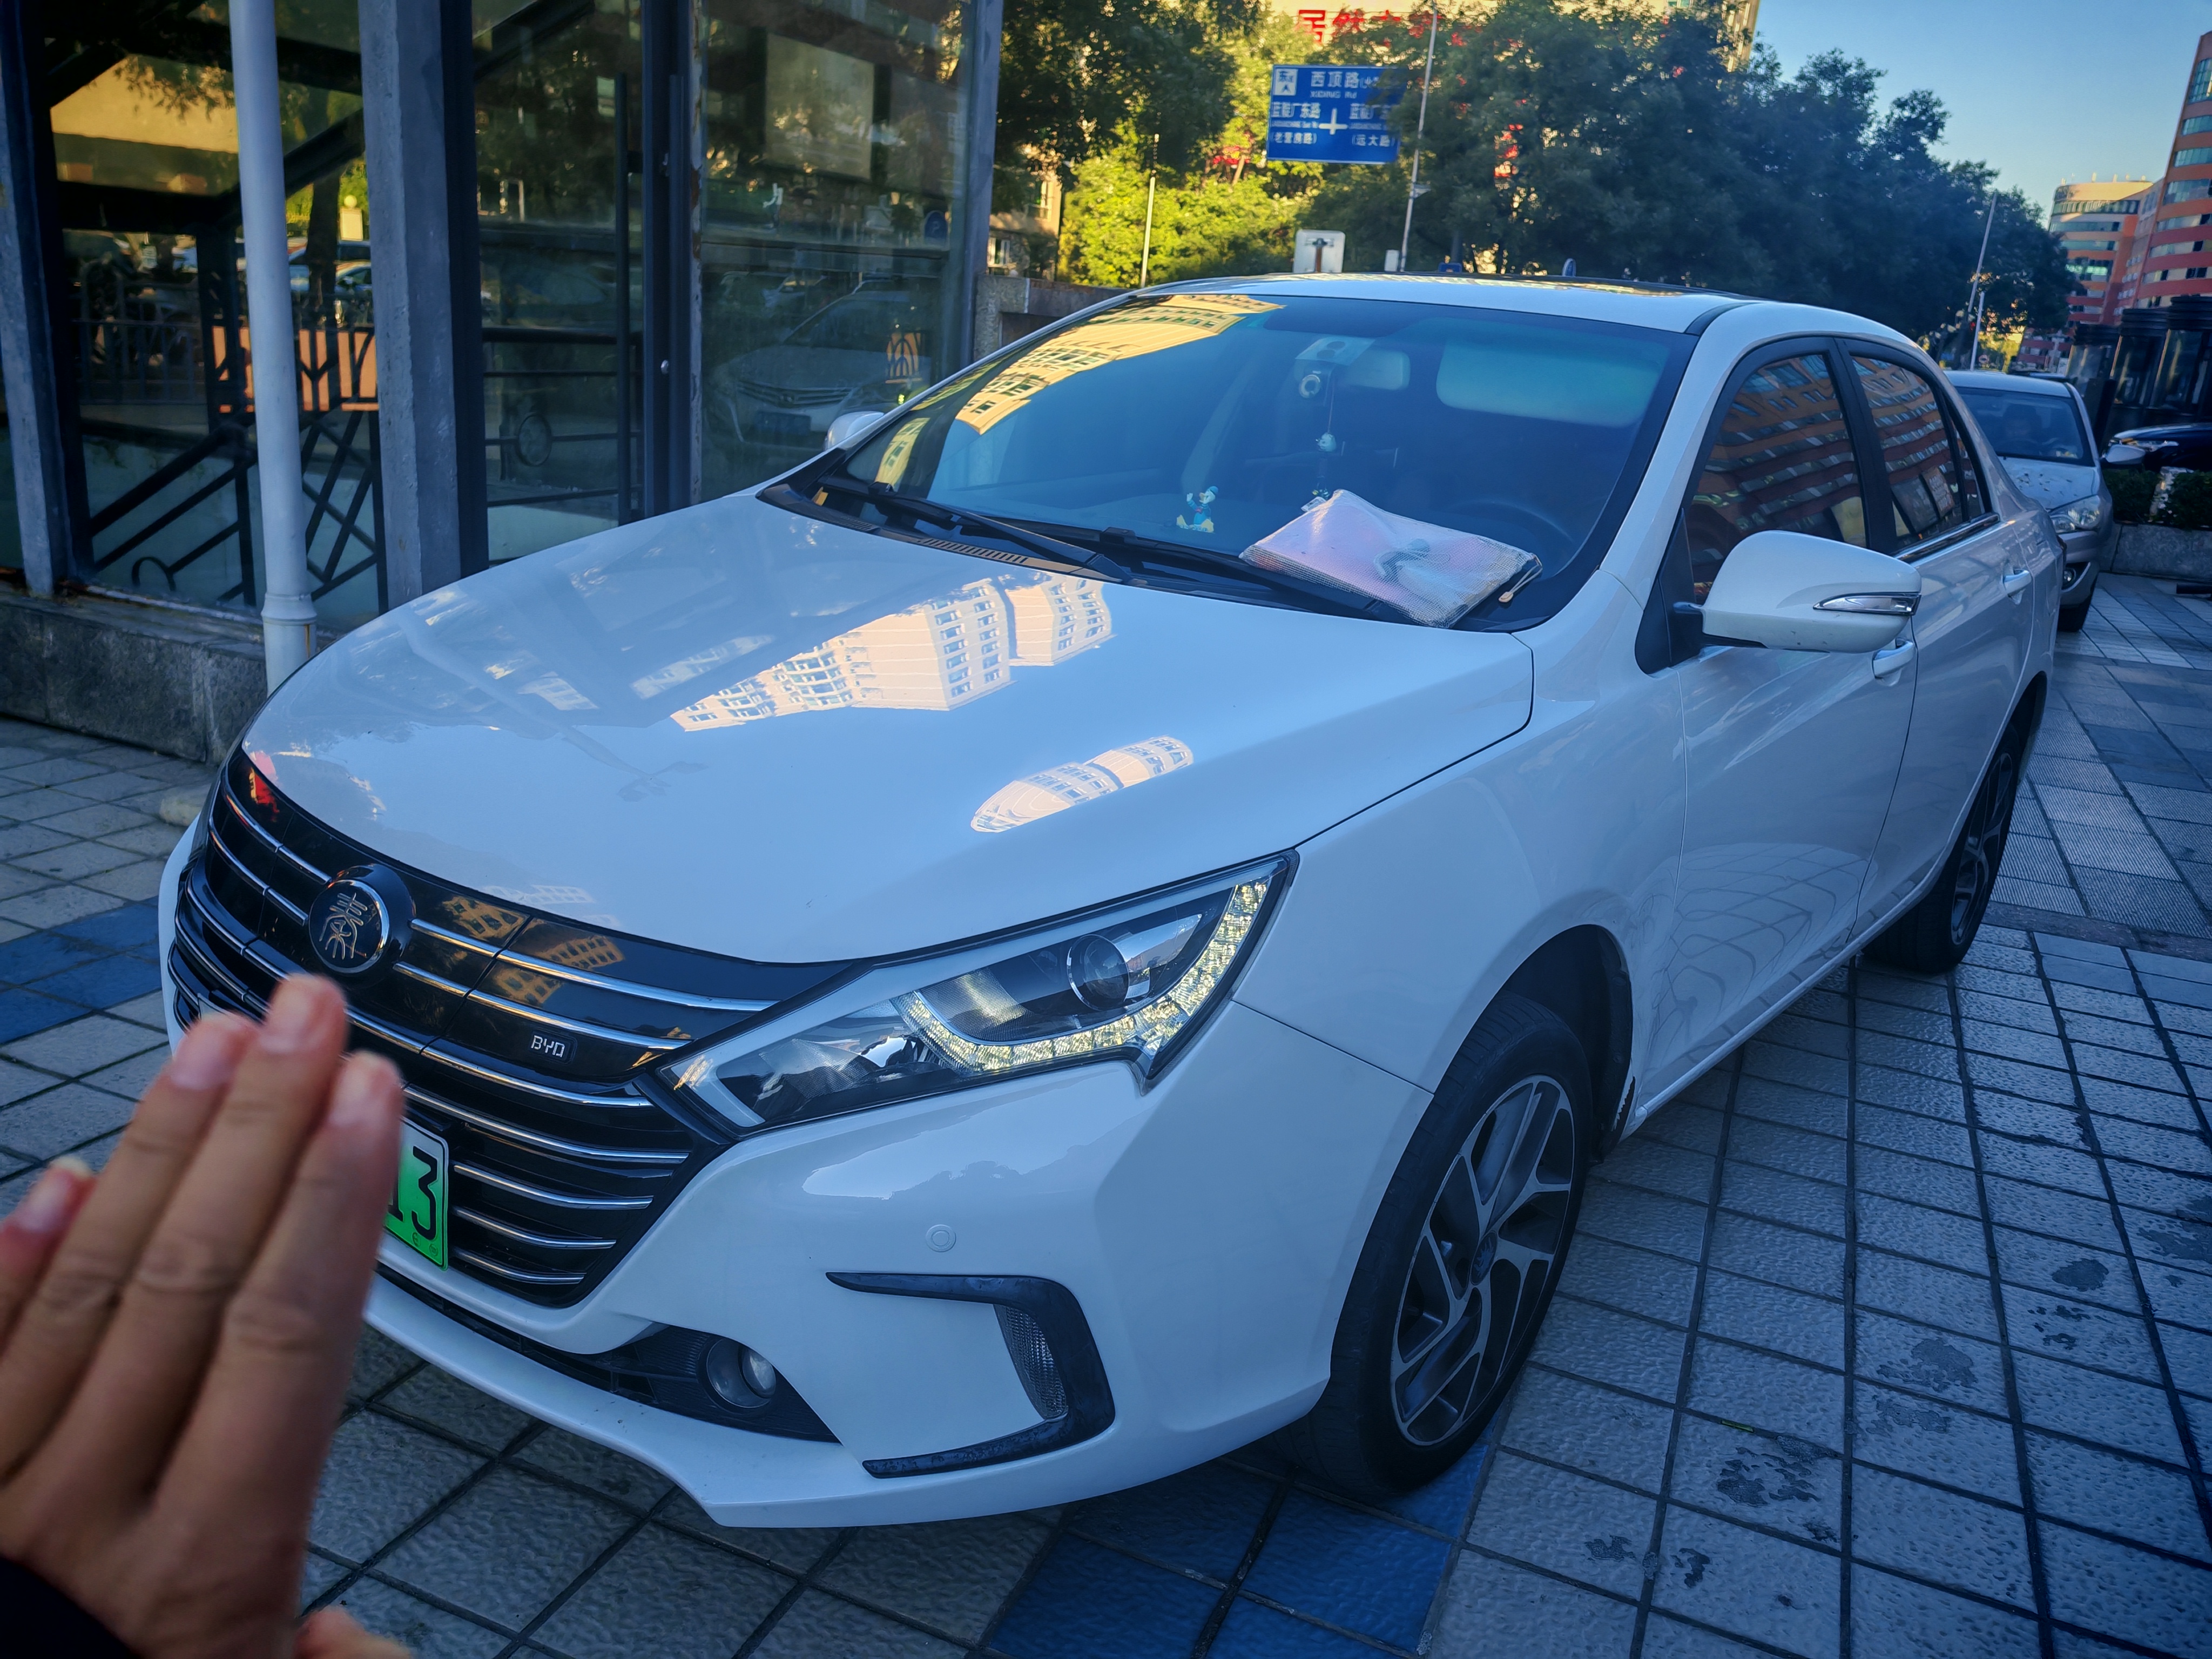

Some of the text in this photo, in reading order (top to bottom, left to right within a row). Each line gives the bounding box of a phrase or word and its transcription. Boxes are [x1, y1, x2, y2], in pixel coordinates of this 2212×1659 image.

[1311, 71, 1359, 89] 西顶路
[531, 1035, 565, 1057] BYD
